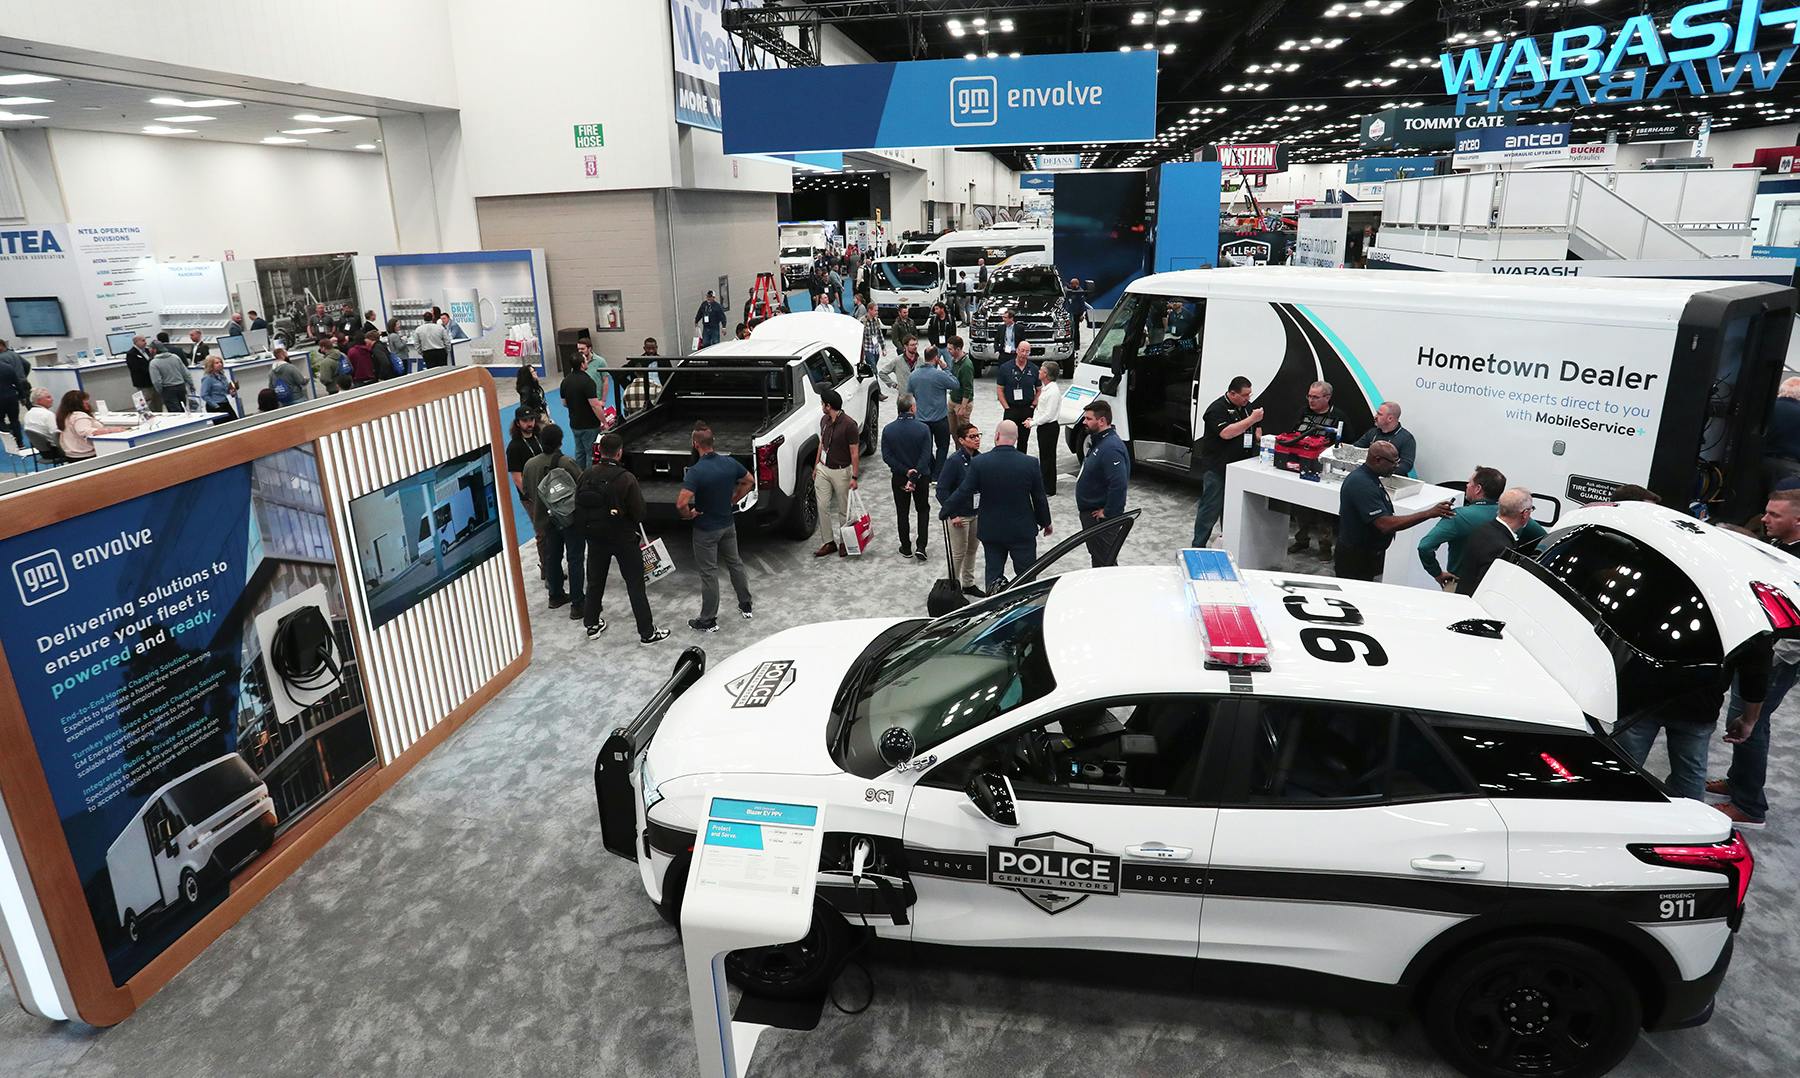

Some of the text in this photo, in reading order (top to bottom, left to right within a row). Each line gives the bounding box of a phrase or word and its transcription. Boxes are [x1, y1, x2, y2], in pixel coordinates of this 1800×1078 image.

[1439, 0, 1800, 95] WABASH
[680, 88, 709, 114] MORE
[958, 80, 1103, 114] gm envolve
[578, 124, 599, 136] FIRE
[1404, 115, 1505, 130] TOMMY GATE
[1635, 126, 1676, 134] EBERHARD
[577, 136, 602, 147] HOSE
[1458, 138, 1480, 151] anteo
[1504, 132, 1564, 149] anteo
[1570, 146, 1605, 154] BUCHER
[1220, 147, 1274, 166] WESTERN
[1568, 154, 1601, 162] hydraulics
[0, 230, 63, 254] TEA
[1492, 266, 1579, 277] WABASH
[1416, 346, 1658, 391] Hometown Dealer
[1415, 377, 1651, 419] Our automotive experts direct to you
[1505, 408, 1532, 422] with
[1572, 483, 1586, 491] TIRE
[1587, 487, 1607, 495] PRICE
[1580, 492, 1611, 502] GUARANT
[23, 527, 152, 593] gm envolve
[36, 561, 228, 653] Delivering solutions to
[44, 589, 210, 675] ensure your fleet is
[51, 608, 216, 699] powered and ready.
[60, 653, 189, 725] End-to-End Home Charging Solutions
[63, 715, 92, 734] Experts
[92, 710, 101, 718] to
[100, 694, 129, 713] facilitate
[135, 673, 169, 694] hassle-free
[169, 664, 186, 676] home
[186, 651, 211, 667] charging
[746, 663, 790, 705] POLICE
[66, 718, 105, 742] experience
[105, 711, 116, 721] for
[116, 703, 131, 716] your
[72, 740, 104, 760] Turnkey
[104, 717, 141, 742] Workplace
[149, 701, 170, 716] Depot
[170, 685, 198, 704] Charging
[199, 669, 226, 688] Solutions
[74, 758, 88, 769] GM
[88, 744, 113, 762] Energy
[113, 727, 140, 747] certified
[141, 711, 169, 732] providers
[176, 699, 190, 710] help
[190, 682, 220, 702] implement
[77, 758, 106, 778] scalable
[106, 746, 127, 761] depot
[126, 729, 155, 749] charging
[83, 768, 122, 796] Integrated
[122, 754, 145, 771] Public
[151, 735, 176, 753] Private
[176, 716, 208, 738] Strategies
[85, 779, 122, 804] Specialists
[122, 773, 130, 781] to
[130, 763, 146, 776] work
[147, 754, 160, 766] with
[160, 747, 173, 758] you
[172, 740, 184, 749] and
[184, 728, 202, 742] create
[206, 718, 220, 729] plan
[88, 805, 97, 813] to
[97, 790, 120, 807] access
[125, 769, 151, 788] national
[151, 754, 177, 772] network
[176, 745, 190, 756] with
[864, 787, 895, 804] 9C1
[923, 859, 973, 871] SERVE
[999, 852, 1111, 881] POLICE
[998, 874, 1108, 891] GENERAL MOTORS
[1136, 875, 1215, 886] PROTECT
[1659, 899, 1695, 919] 911
